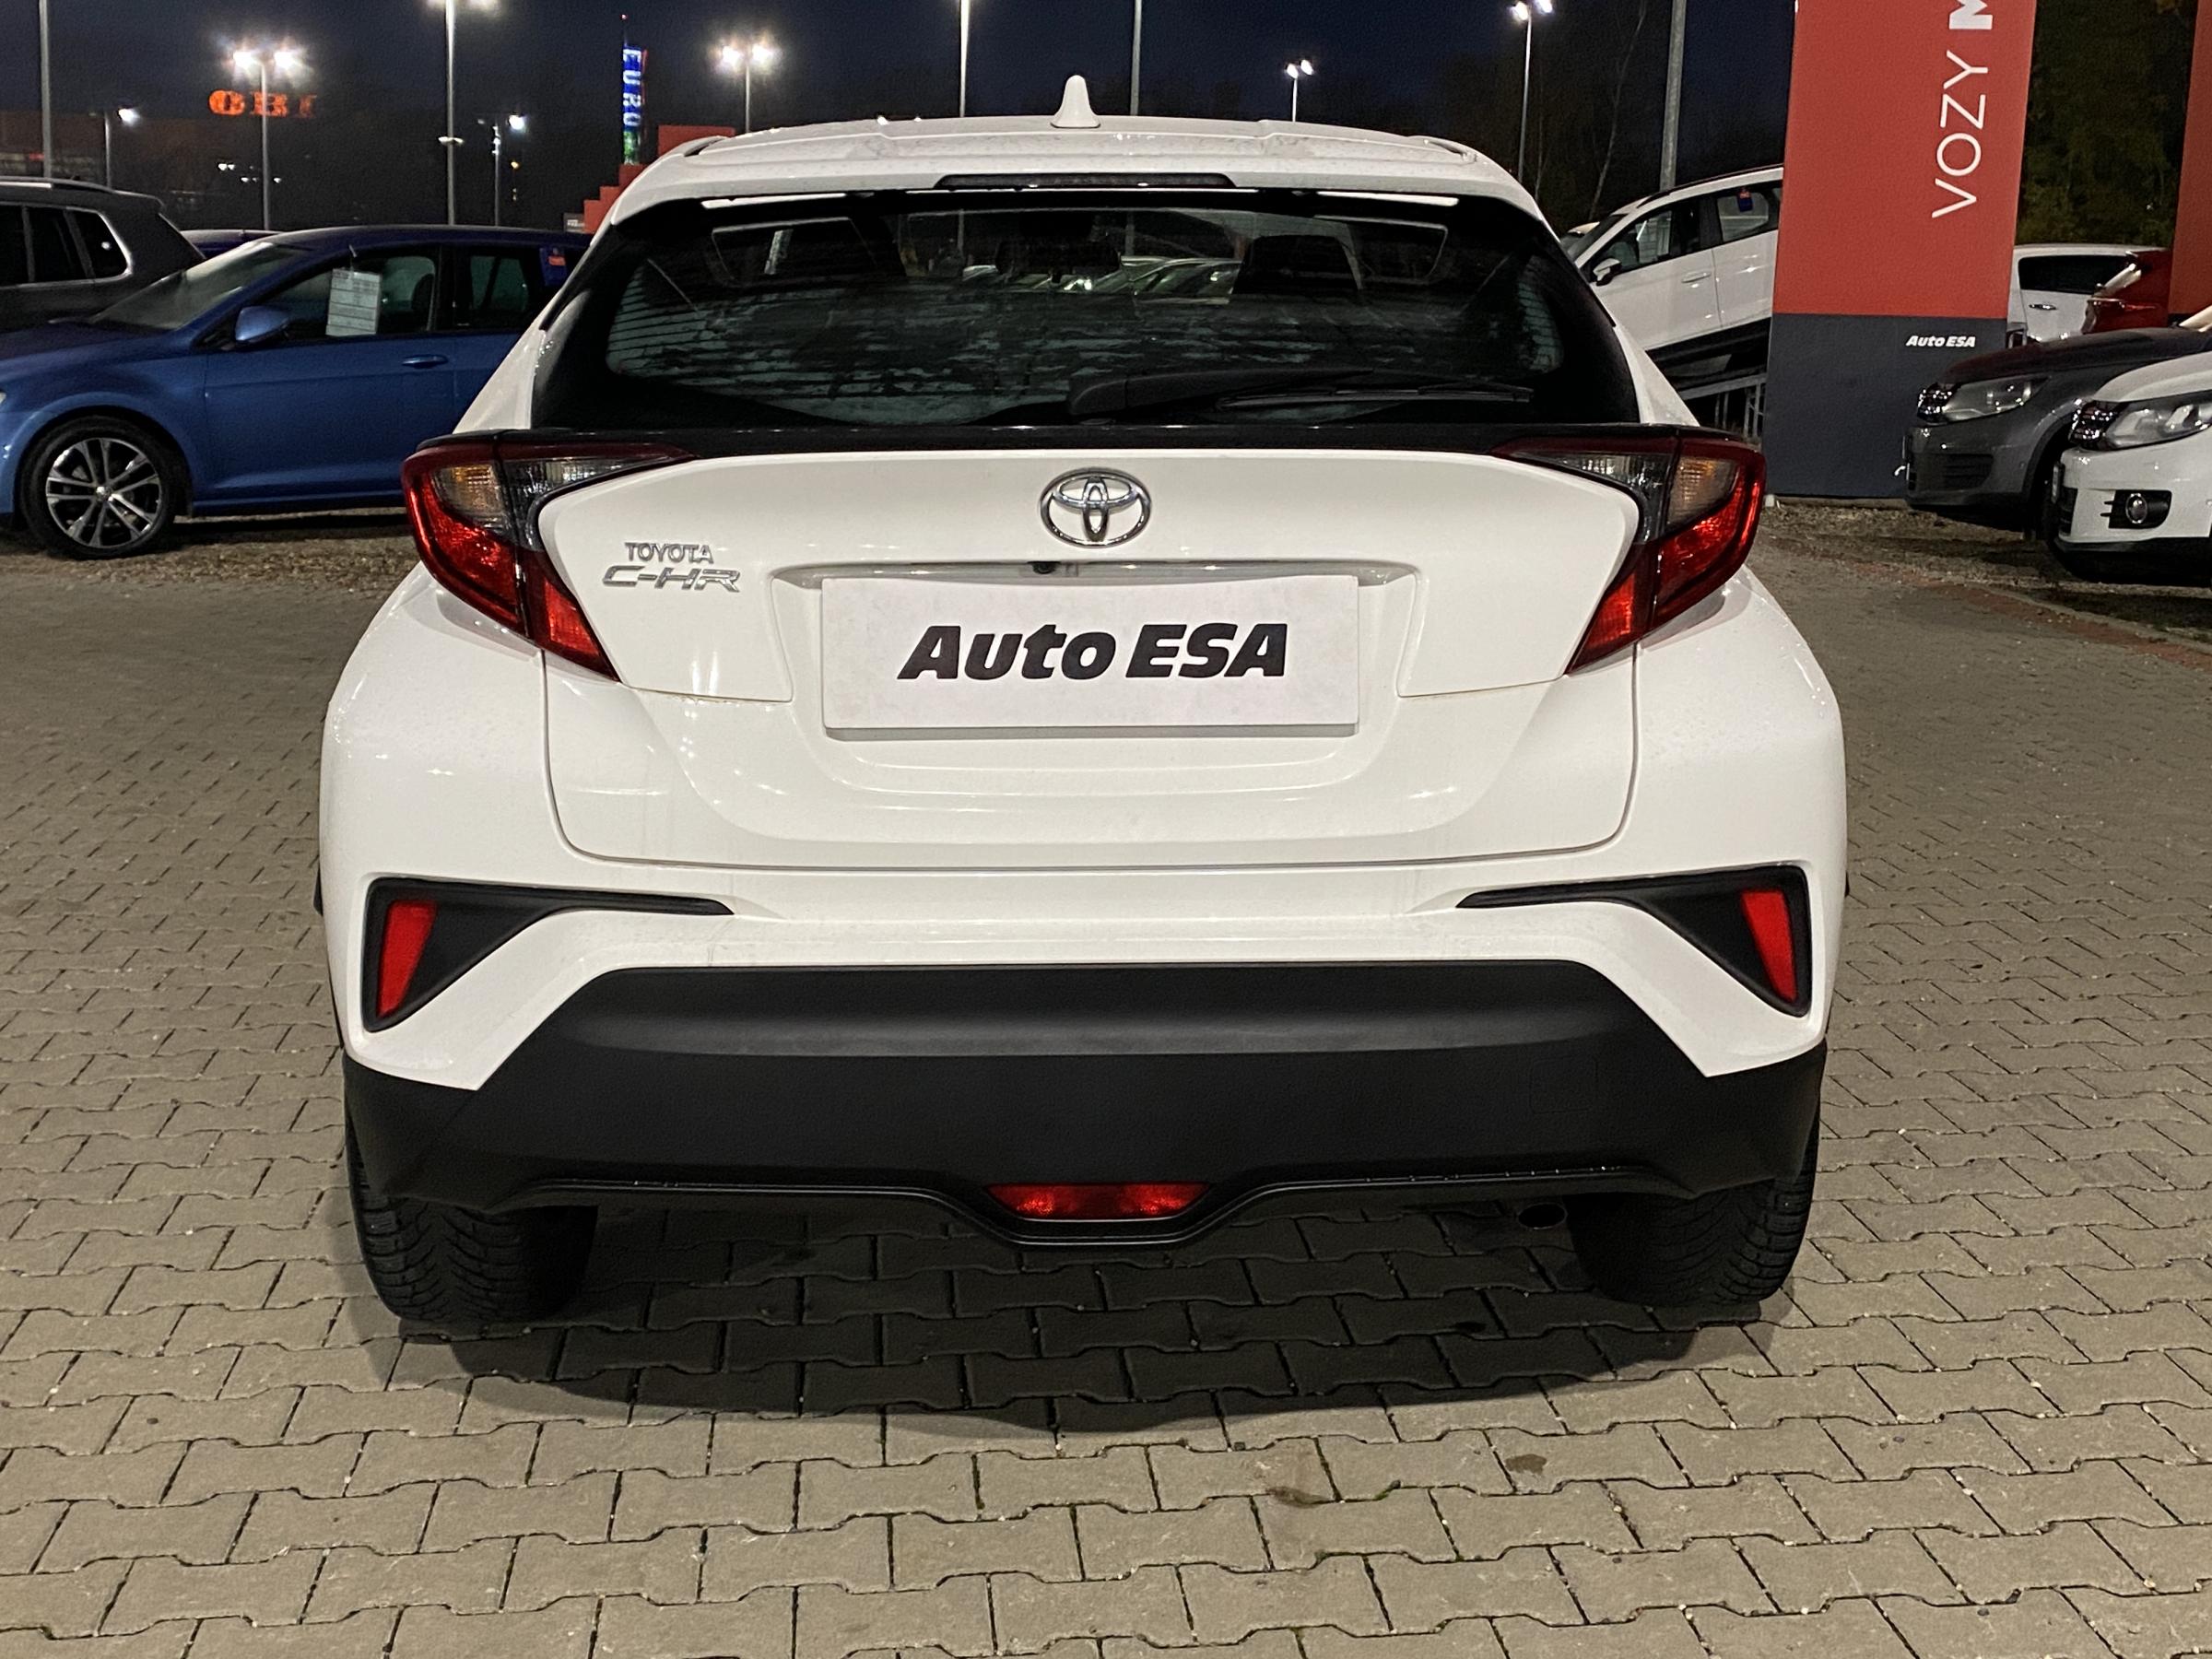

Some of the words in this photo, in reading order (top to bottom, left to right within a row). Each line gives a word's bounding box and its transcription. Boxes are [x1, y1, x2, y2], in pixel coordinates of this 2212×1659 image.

[208, 88, 318, 118] OBI
[1932, 50, 1989, 218] VOZY
[1905, 335, 1946, 347] Auto
[1946, 335, 1976, 347] ESA
[624, 541, 714, 565] TOYOTA
[602, 564, 741, 594] C-HR
[897, 623, 1117, 680] Auto
[1124, 622, 1288, 678] ESA
